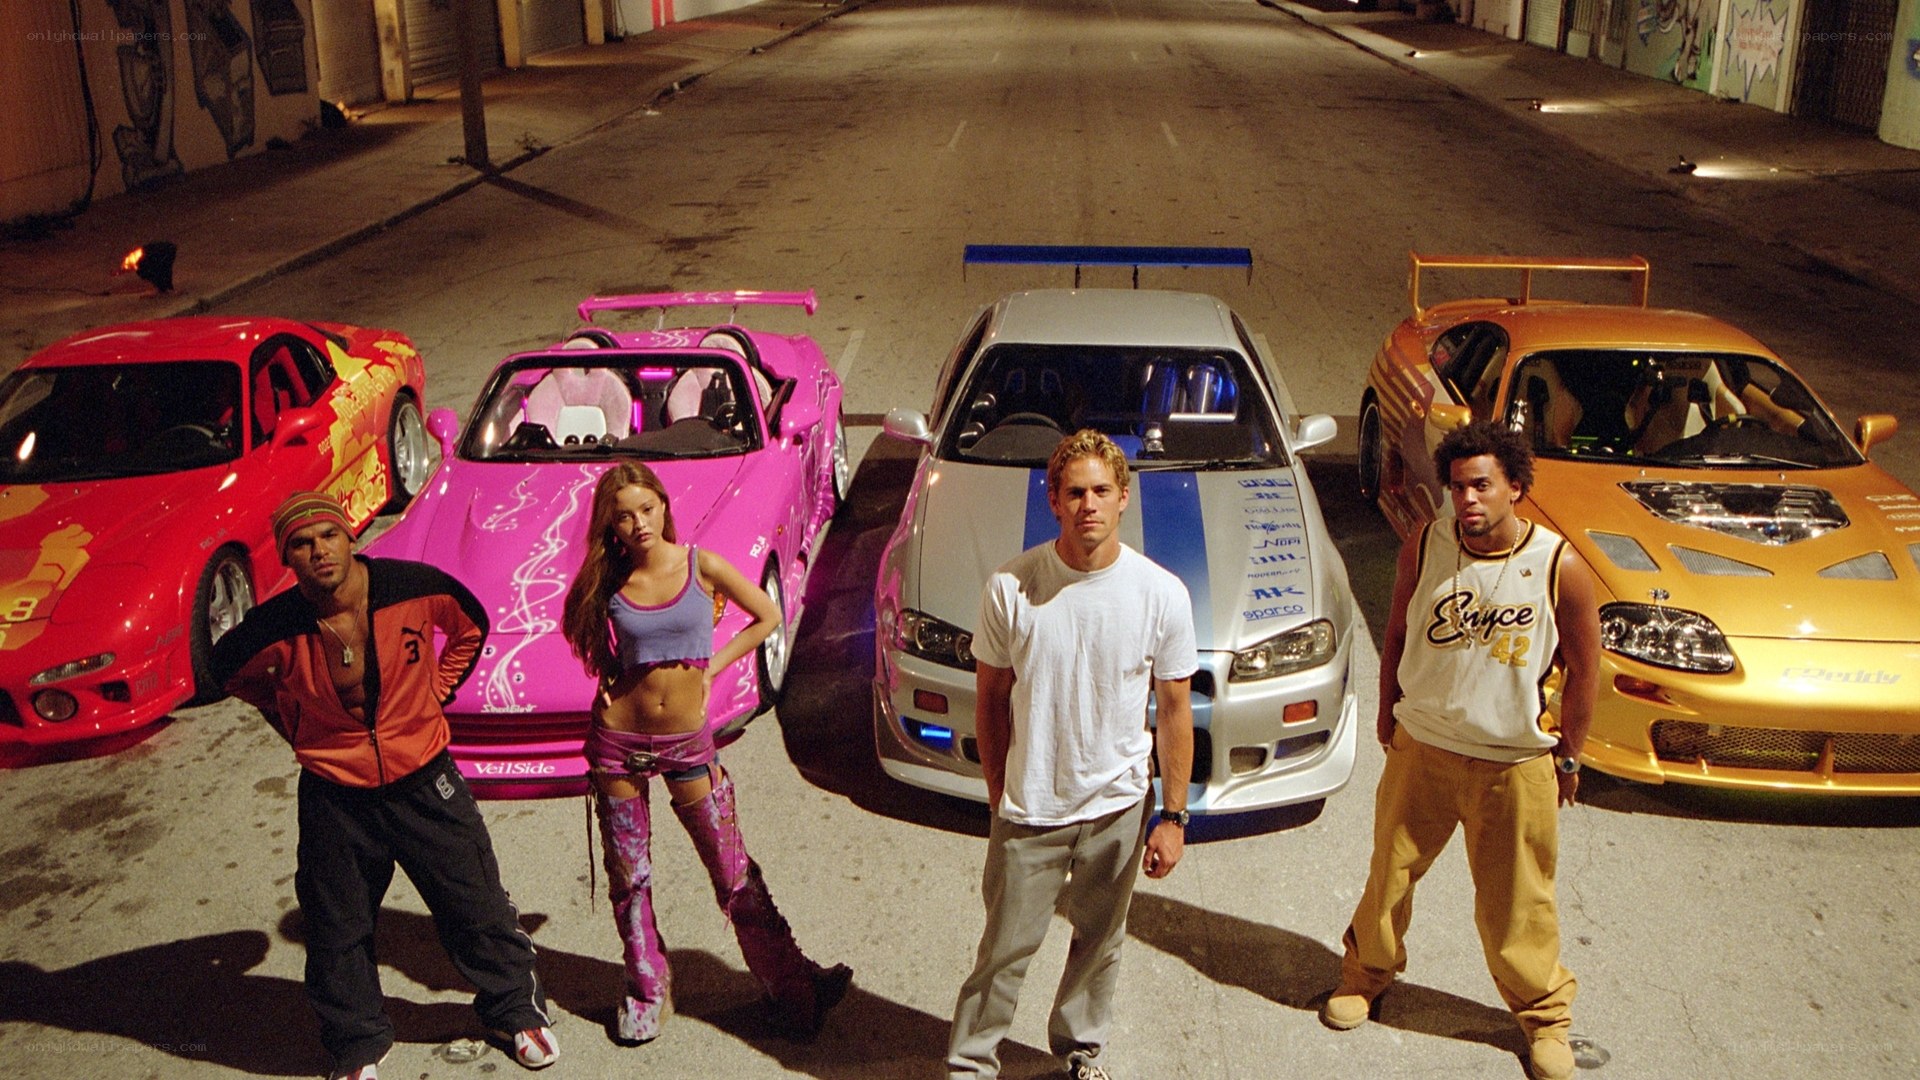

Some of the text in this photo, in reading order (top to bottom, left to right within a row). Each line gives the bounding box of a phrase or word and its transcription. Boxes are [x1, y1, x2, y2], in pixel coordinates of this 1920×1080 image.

[1253, 536, 1301, 550] NOPI
[1243, 603, 1304, 621] sparco
[1426, 589, 1535, 645] Enyce
[404, 640, 420, 666] 3
[1491, 633, 1531, 667] 42
[474, 761, 556, 775] VeilSide
